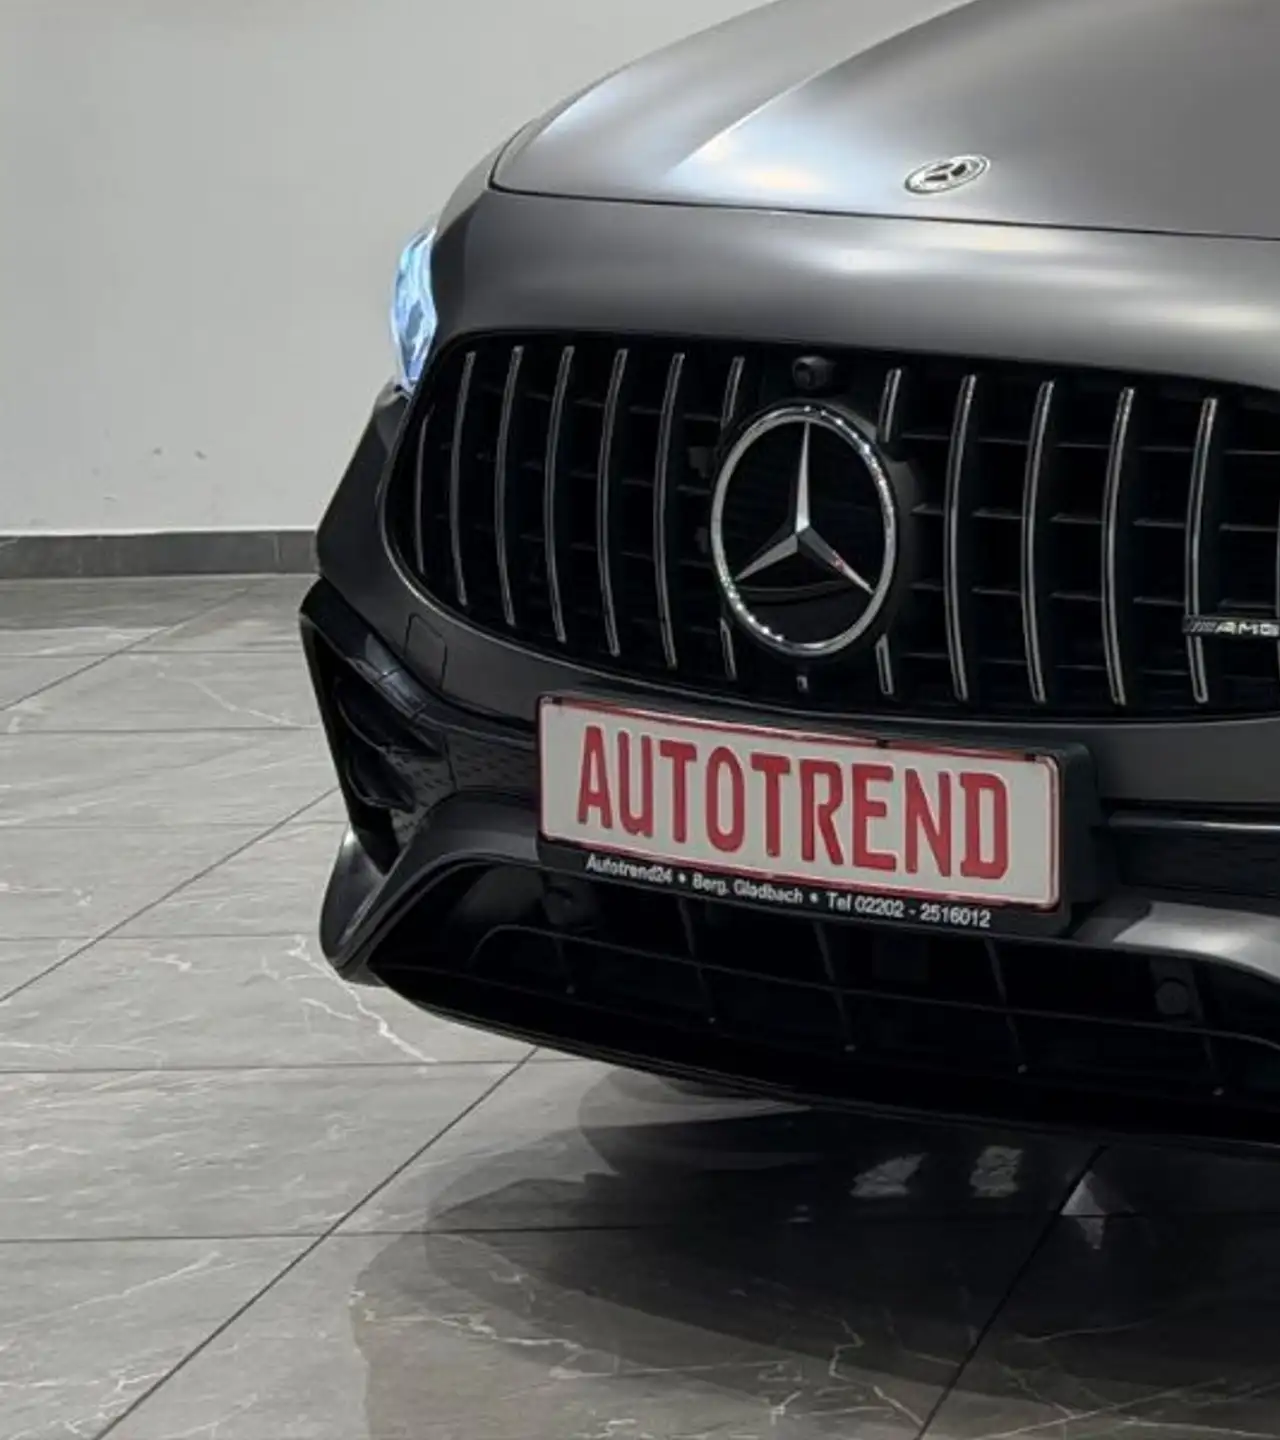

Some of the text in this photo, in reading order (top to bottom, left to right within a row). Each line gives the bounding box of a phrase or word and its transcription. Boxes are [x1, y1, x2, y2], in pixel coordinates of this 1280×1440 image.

[1215, 620, 1280, 637] AMG
[577, 724, 1011, 881] AUTOTREND
[585, 853, 673, 885] Autotrend24
[692, 872, 729, 896] Berg.
[733, 879, 803, 904] Gladbach
[826, 891, 851, 910] Tel
[854, 895, 905, 918] 02202
[919, 902, 991, 928] 2516012
